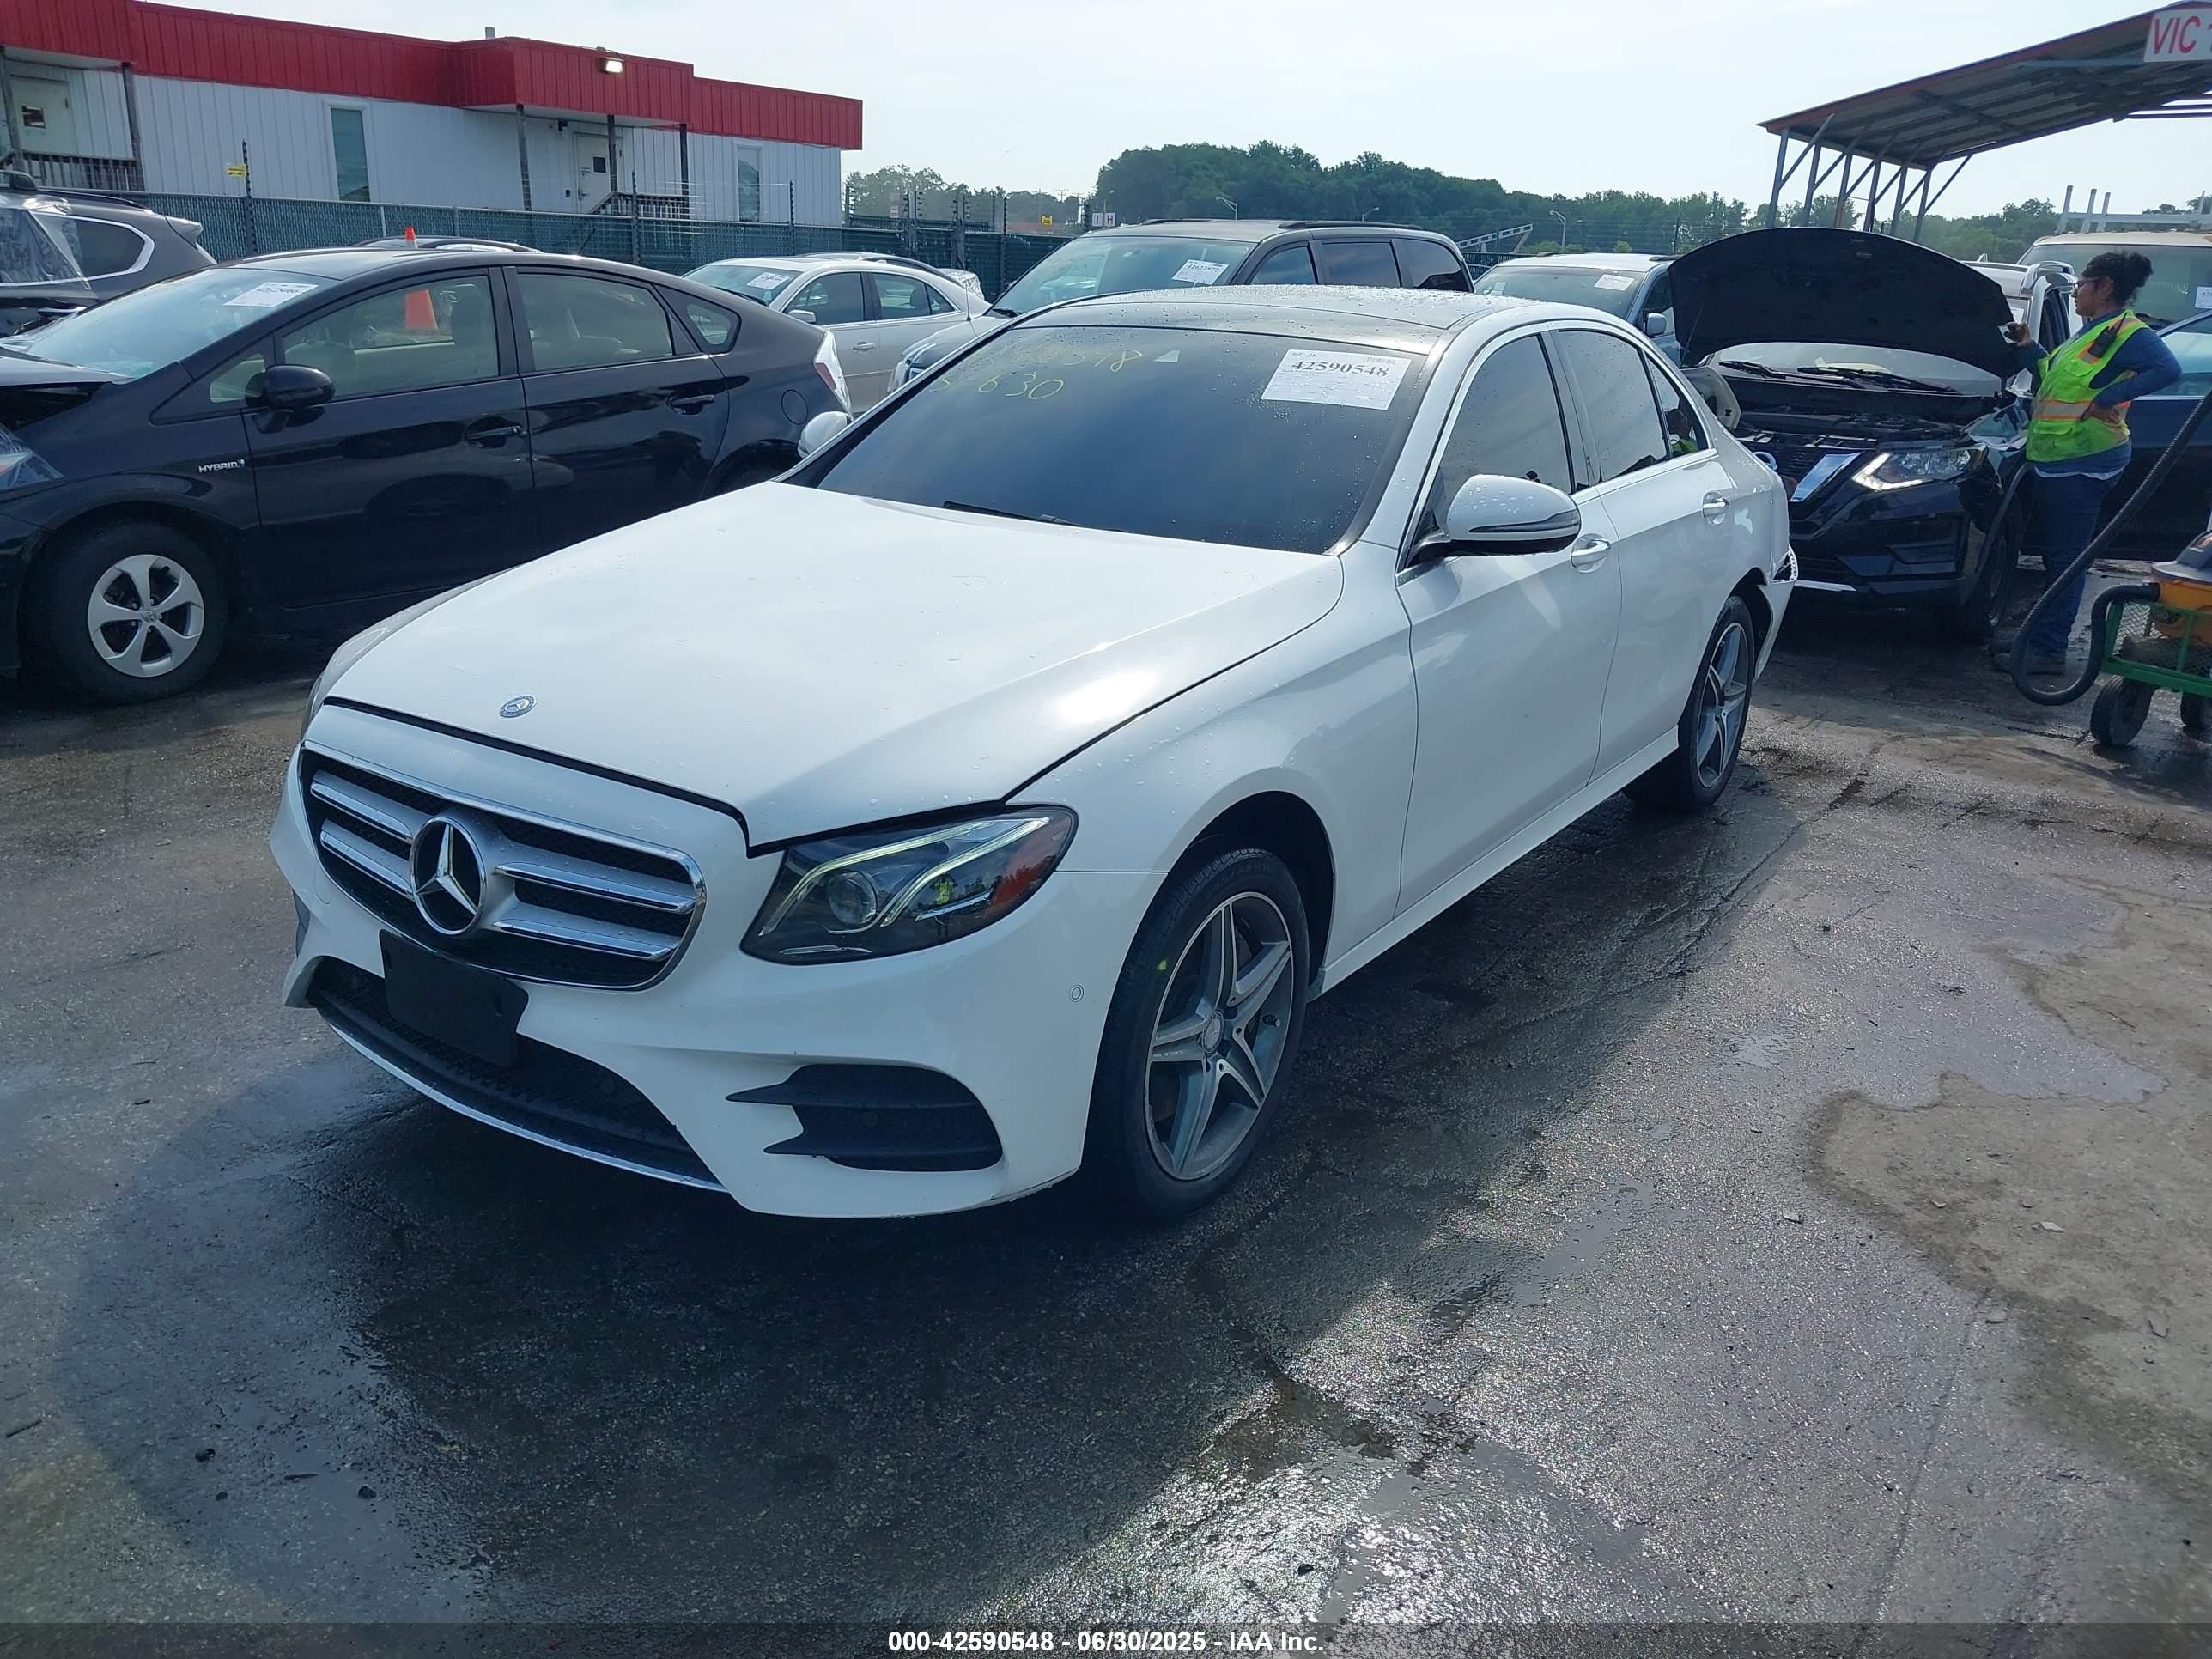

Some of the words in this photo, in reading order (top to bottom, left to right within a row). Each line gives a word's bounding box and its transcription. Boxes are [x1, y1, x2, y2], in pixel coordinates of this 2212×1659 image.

[2154, 15, 2201, 55] VIC
[1291, 360, 1390, 378] 42590548
[198, 461, 238, 473] HYBRID
